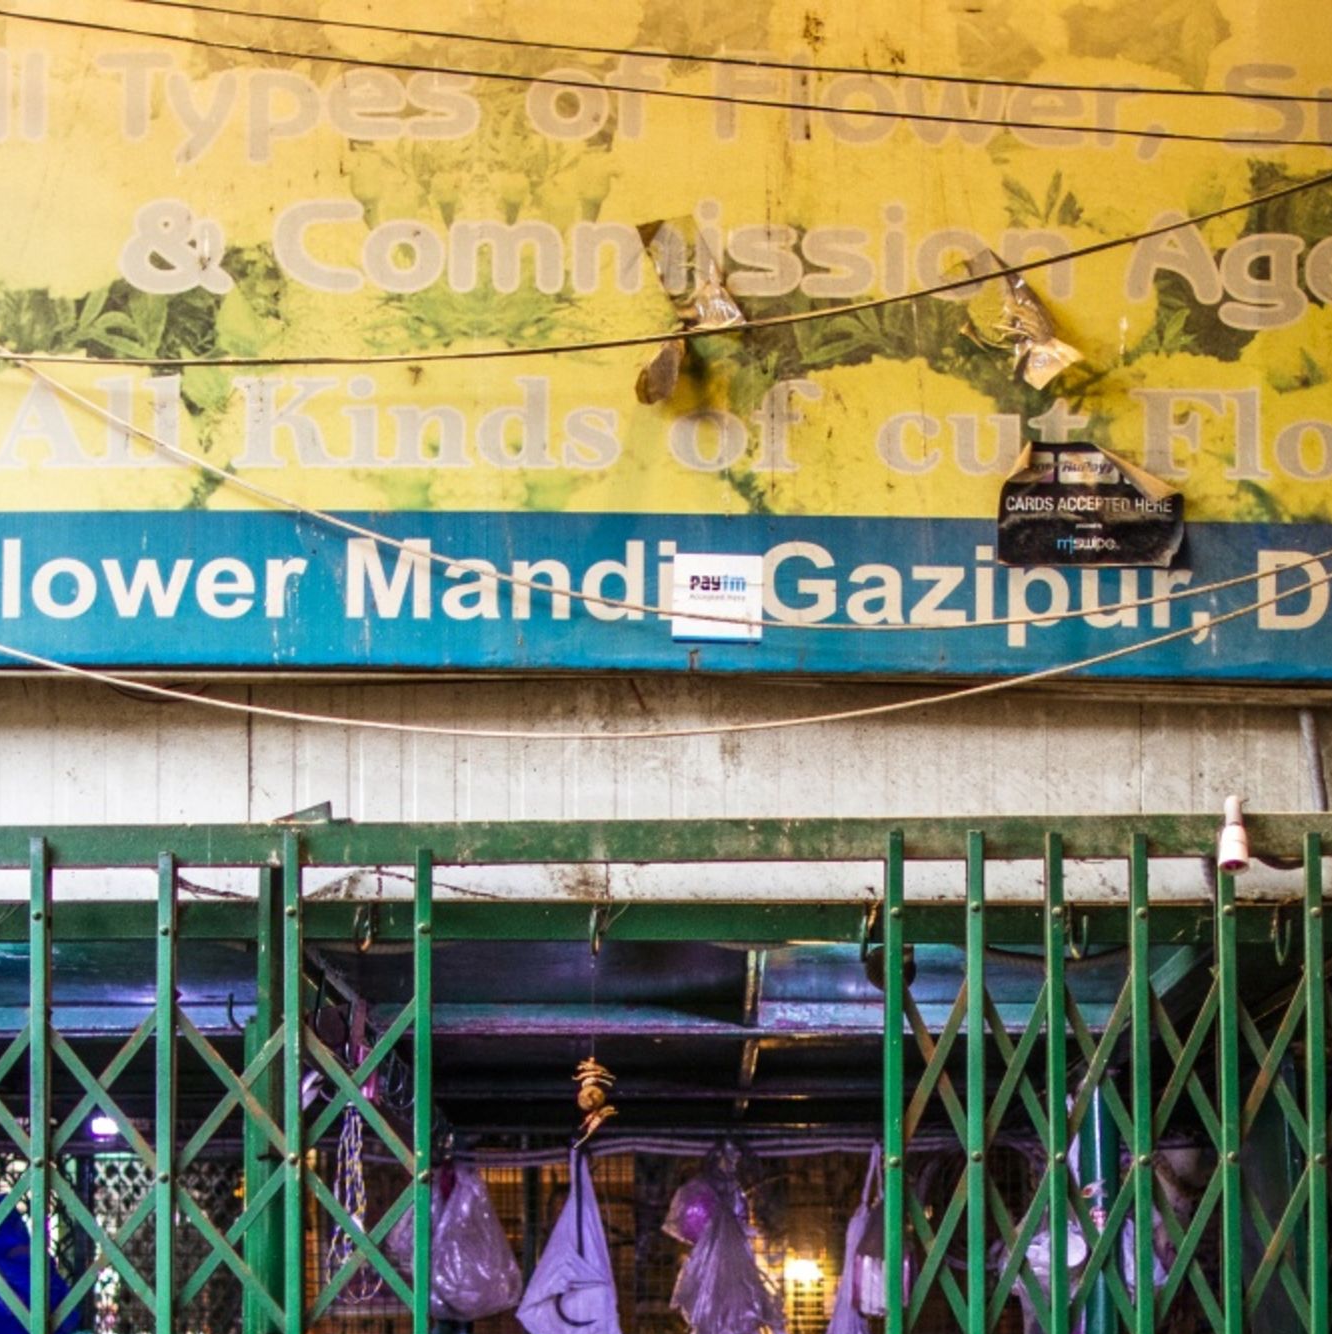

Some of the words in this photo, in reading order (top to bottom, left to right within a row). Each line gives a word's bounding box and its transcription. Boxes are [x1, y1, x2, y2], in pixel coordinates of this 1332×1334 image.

[94, 51, 481, 163] Types
[526, 52, 663, 142] of
[714, 47, 1168, 163] Flower,
[119, 198, 233, 295] &
[273, 198, 1073, 300] Commission
[234, 372, 623, 474] Kinds
[668, 377, 823, 475] of
[1005, 495, 1055, 512] CARDS
[1057, 495, 1131, 513] ACCEPTED
[1134, 497, 1173, 513] HERE
[348, 538, 677, 622] Mandi
[761, 540, 1213, 646] Gazipur,
